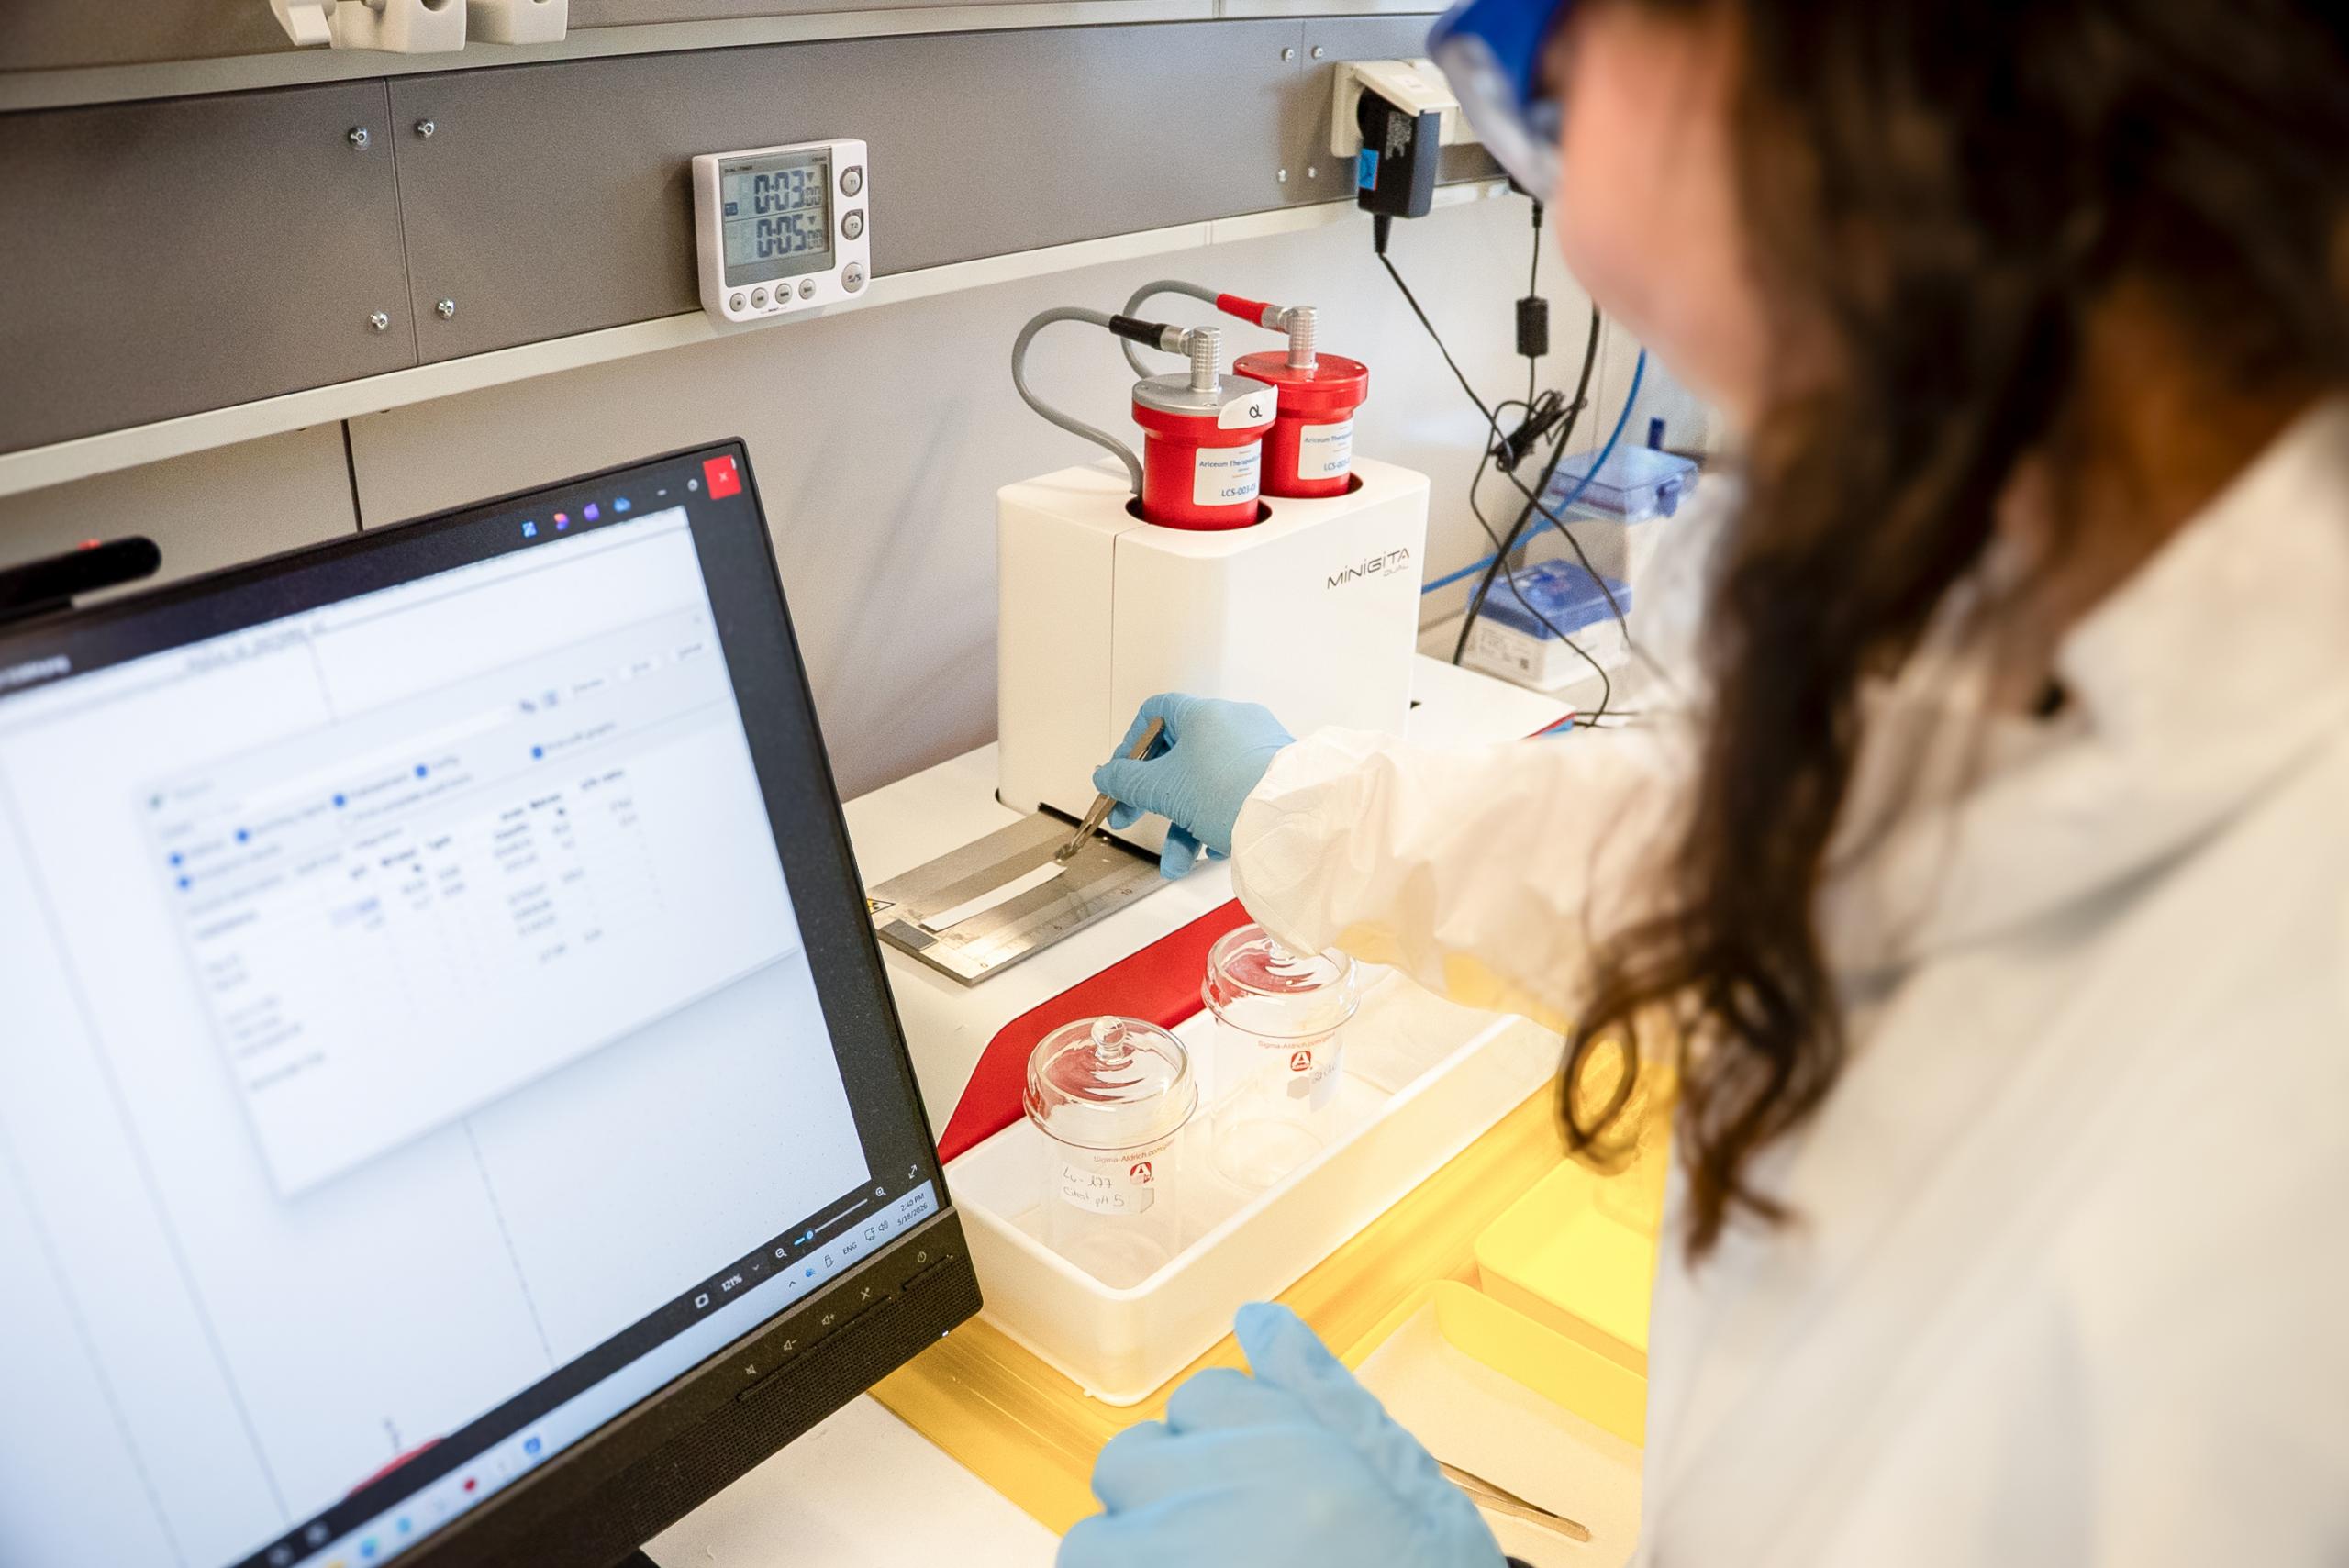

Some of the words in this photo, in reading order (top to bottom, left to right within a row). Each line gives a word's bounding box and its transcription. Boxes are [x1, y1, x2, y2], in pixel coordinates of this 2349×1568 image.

[754, 170, 805, 214] 0:03
[757, 213, 807, 258] 0:05
[914, 1193, 925, 1204] PM
[842, 1241, 858, 1255] ENG
